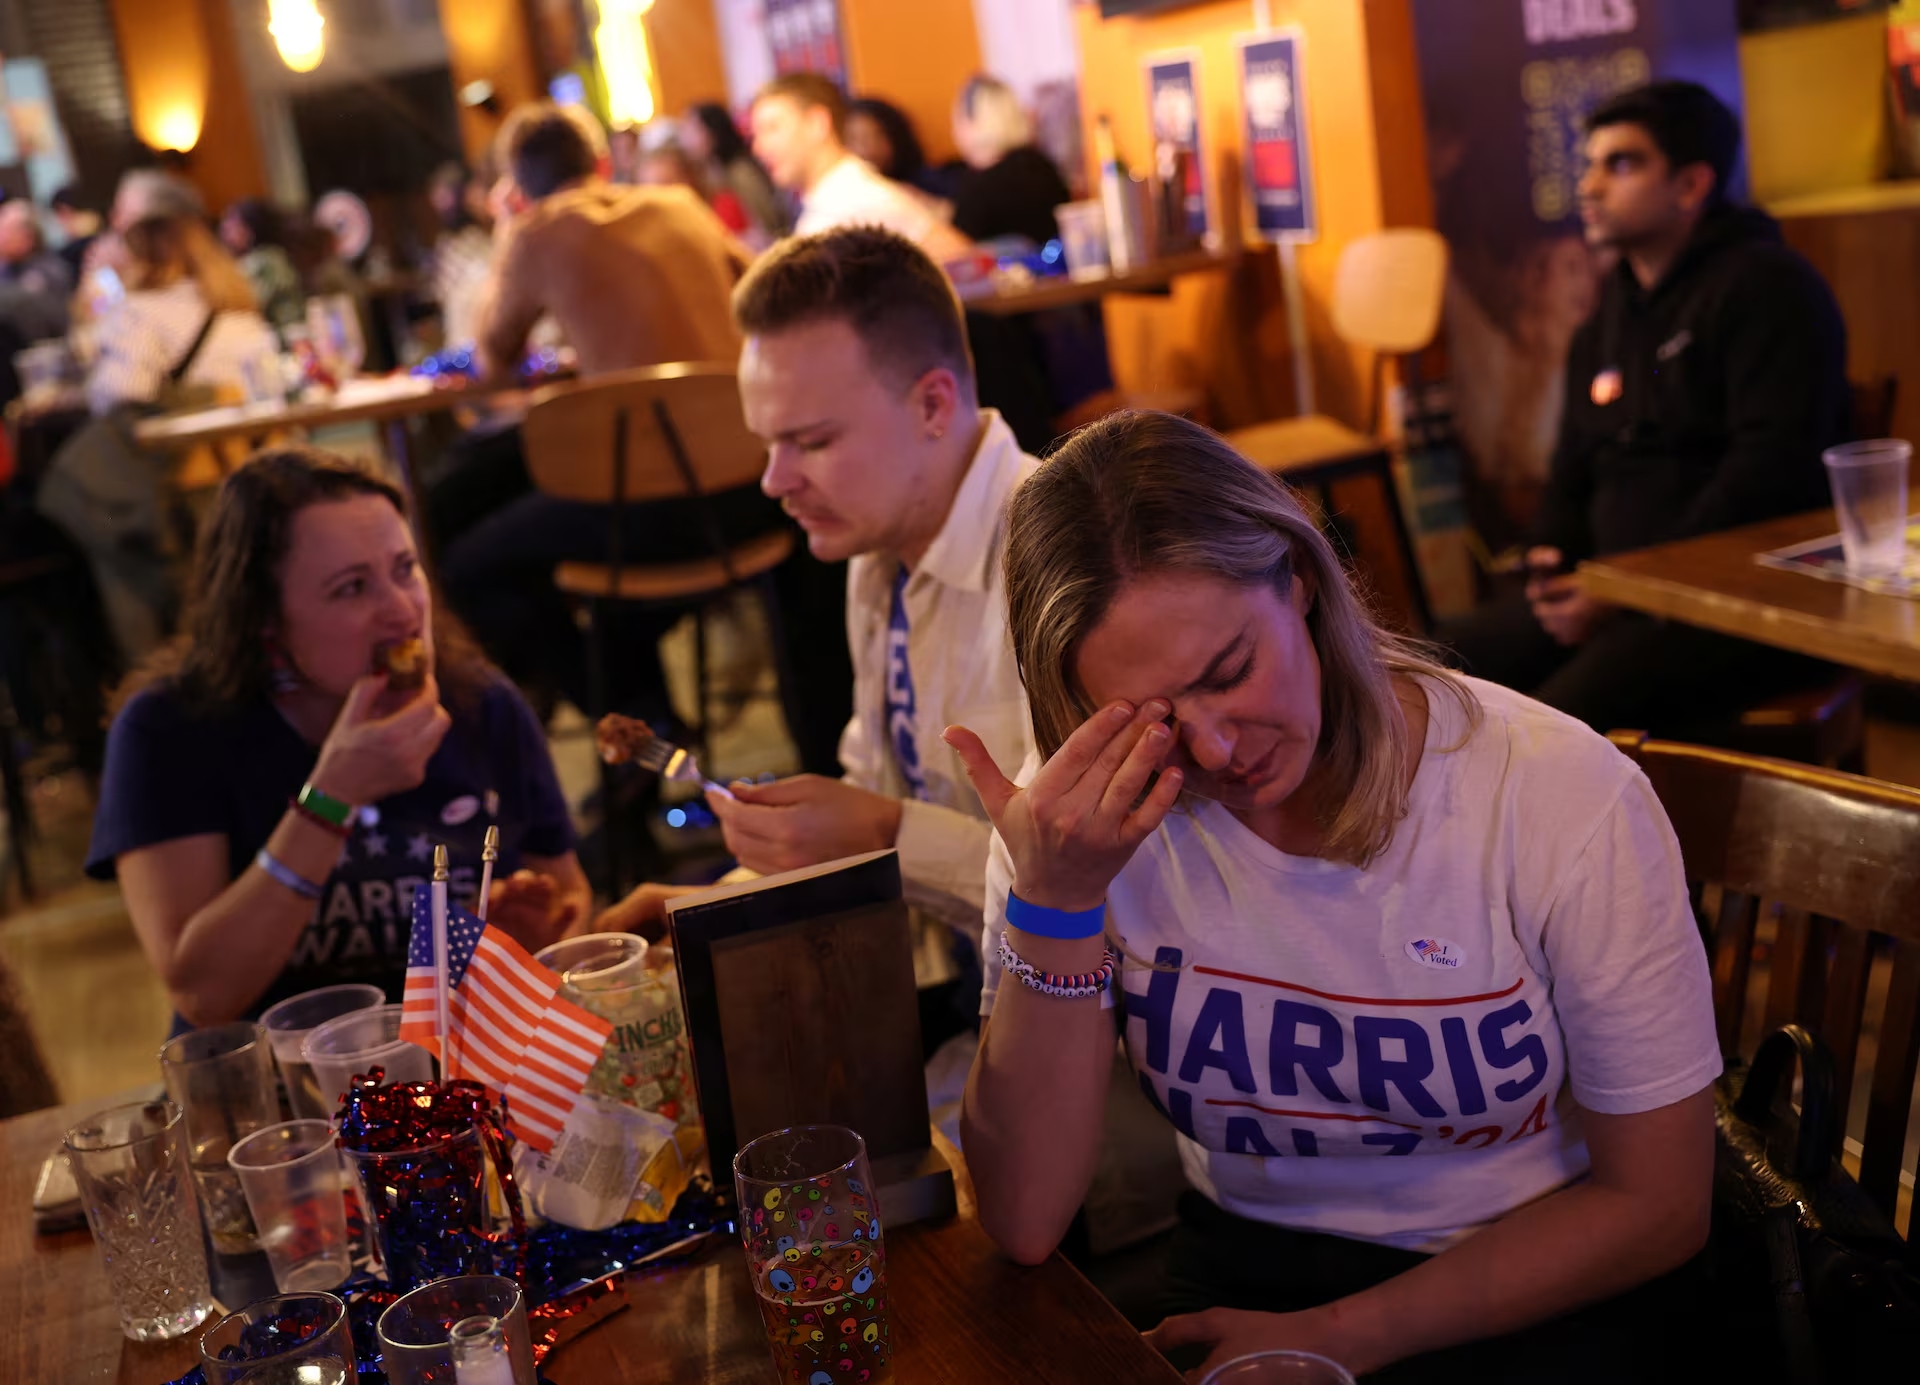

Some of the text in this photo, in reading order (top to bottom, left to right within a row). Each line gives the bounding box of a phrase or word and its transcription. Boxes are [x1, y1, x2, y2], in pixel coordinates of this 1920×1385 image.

[1442, 945, 1448, 955] I
[1430, 953, 1458, 967] Voted
[1117, 937, 1548, 1118] HARRIS
